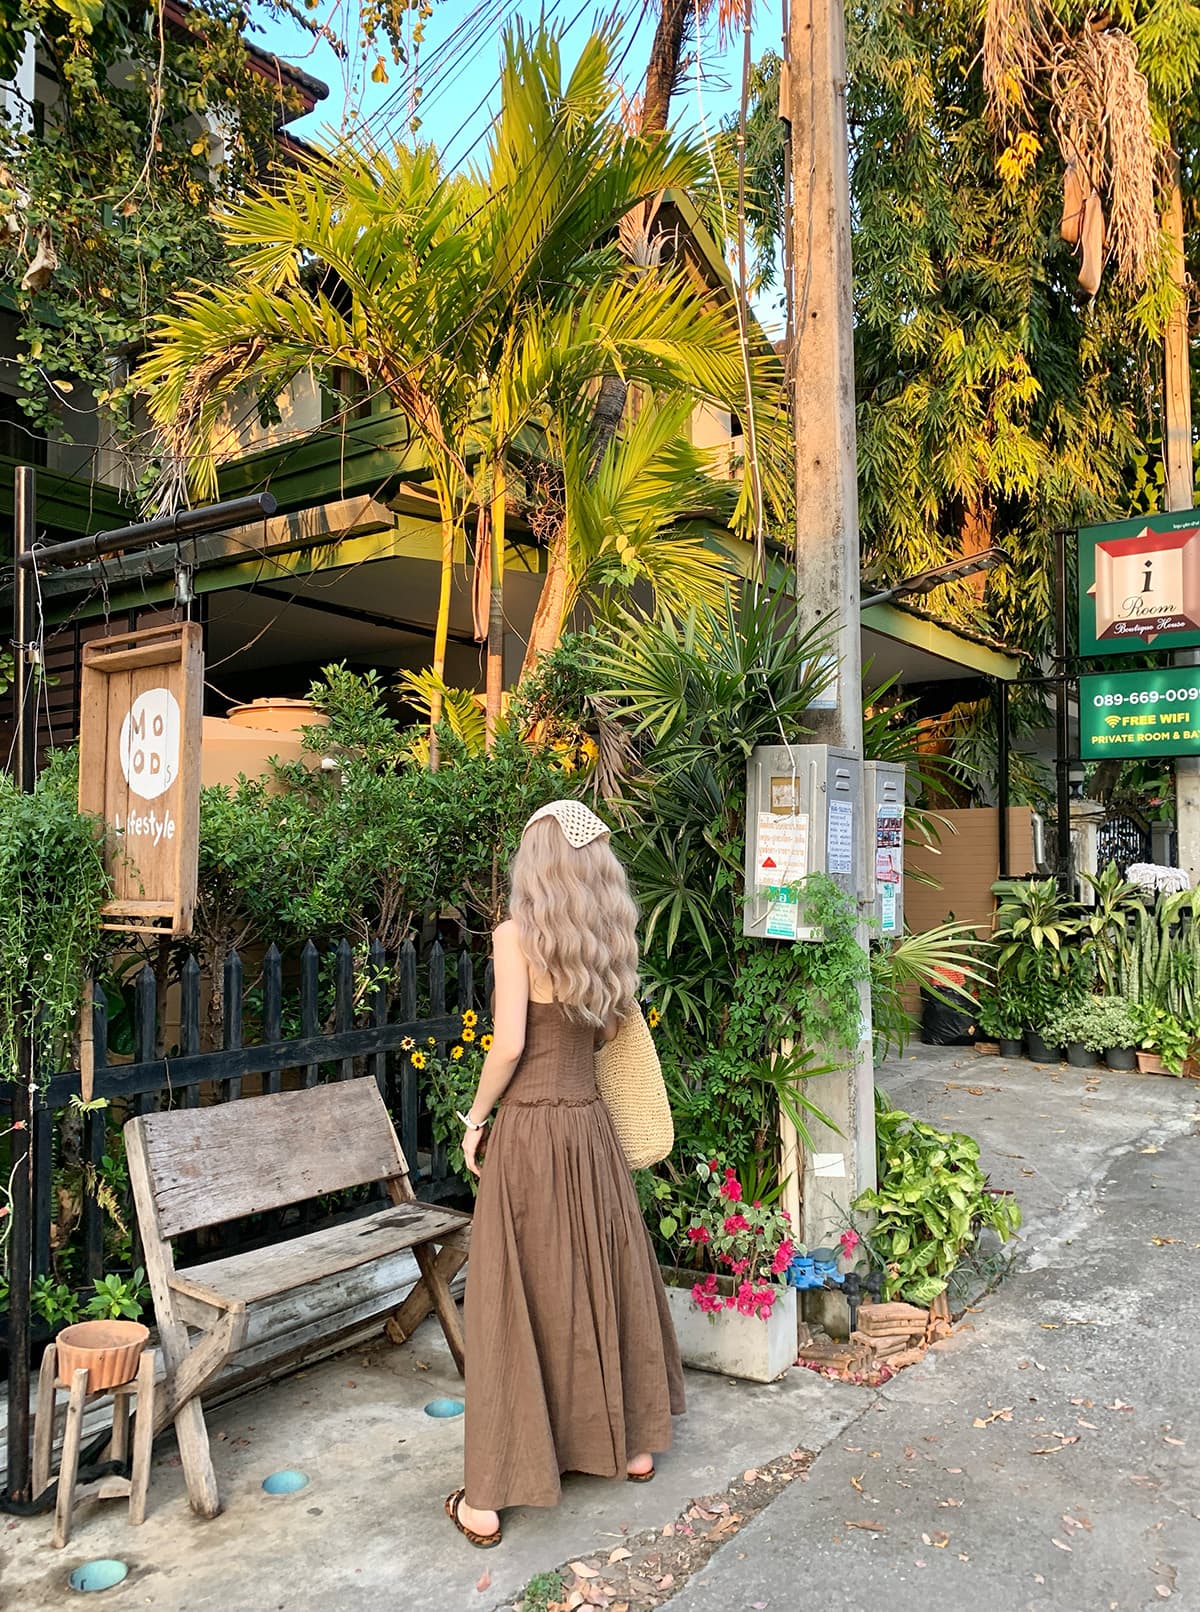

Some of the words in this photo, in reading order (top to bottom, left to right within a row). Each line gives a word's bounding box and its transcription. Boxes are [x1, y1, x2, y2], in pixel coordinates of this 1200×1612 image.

[1141, 559, 1153, 593] i
[1118, 595, 1177, 618] Room
[1114, 622, 1154, 635] Boutique
[1157, 617, 1186, 630] House
[1093, 688, 1200, 707] 089-669-009
[1122, 715, 1156, 726] FREE
[1160, 712, 1190, 724] WIFI
[1091, 734, 1135, 744] PRIVATE
[1137, 732, 1170, 742] ROOM
[1173, 731, 1180, 740] &
[115, 808, 175, 847] Lifestyle
